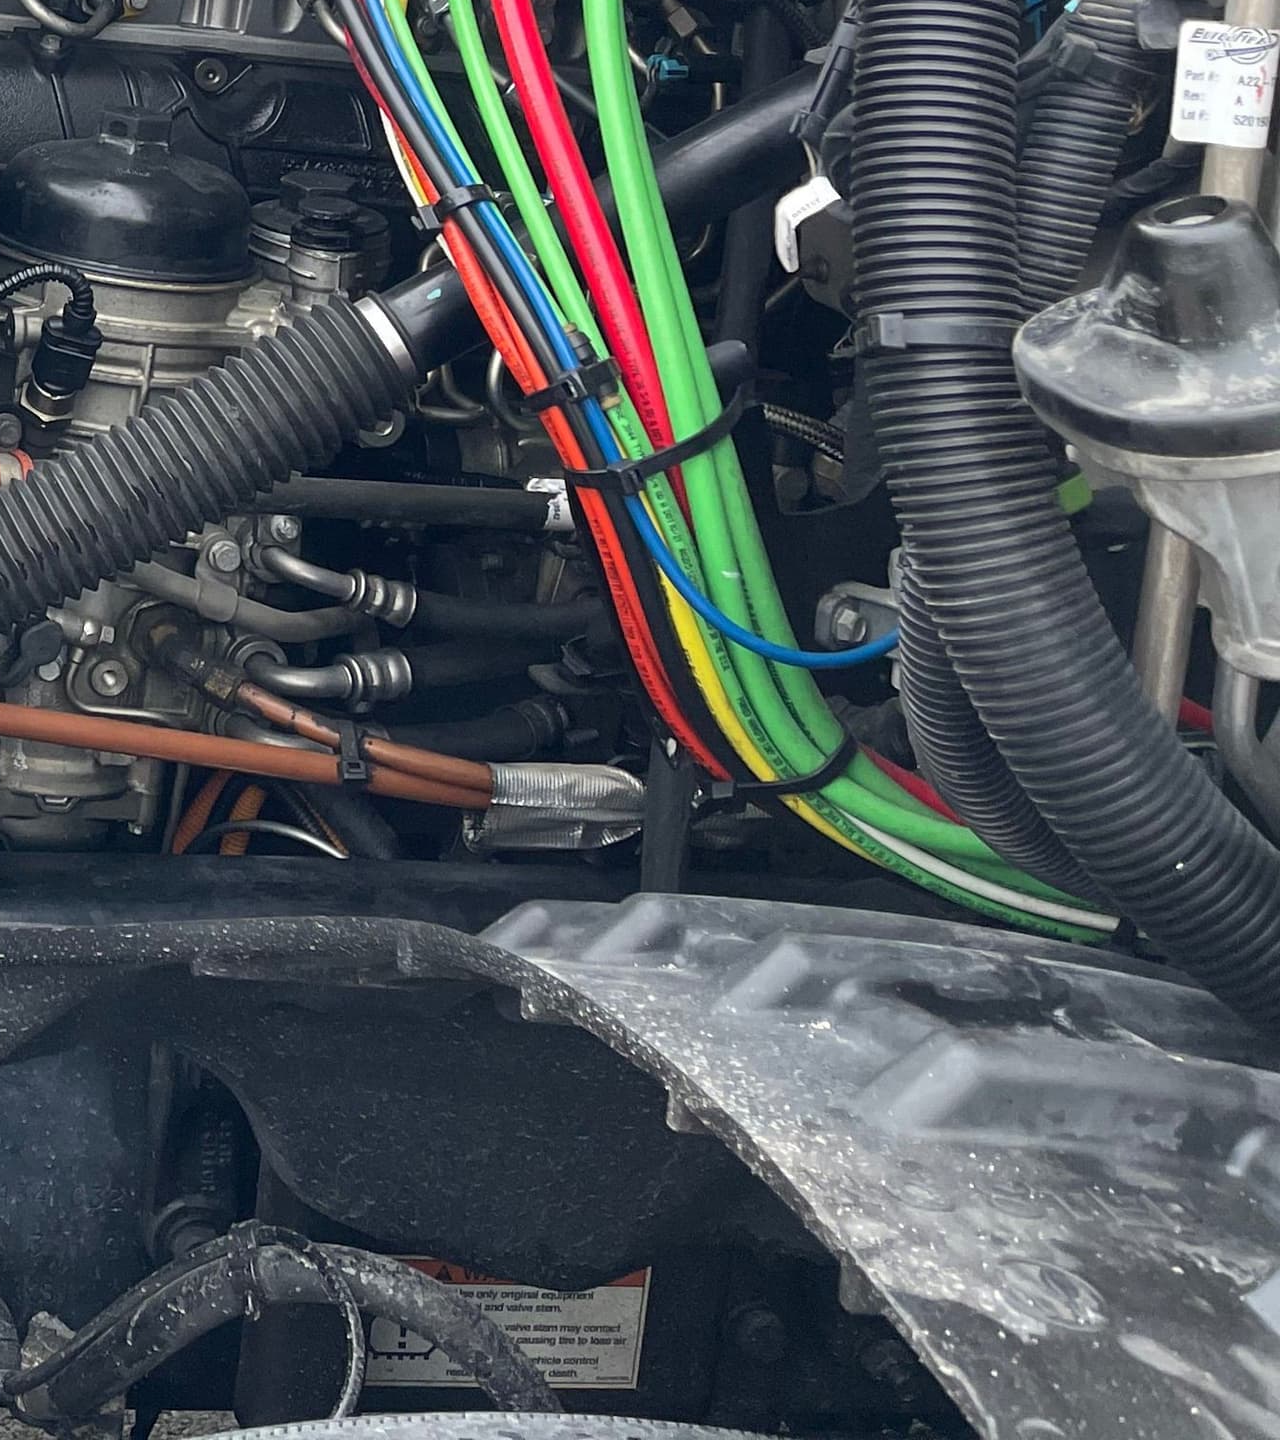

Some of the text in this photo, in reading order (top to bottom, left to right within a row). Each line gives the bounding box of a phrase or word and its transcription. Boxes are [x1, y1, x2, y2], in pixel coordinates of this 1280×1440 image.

[476, 1290, 497, 1302] only
[500, 1290, 539, 1302] original
[541, 1291, 595, 1303] equipment
[484, 1302, 504, 1313] and
[506, 1303, 533, 1313] valve
[504, 1323, 622, 1335] valve stem may contact
[515, 1336, 556, 1348] causing
[558, 1336, 575, 1346] tire
[577, 1336, 588, 1346] to
